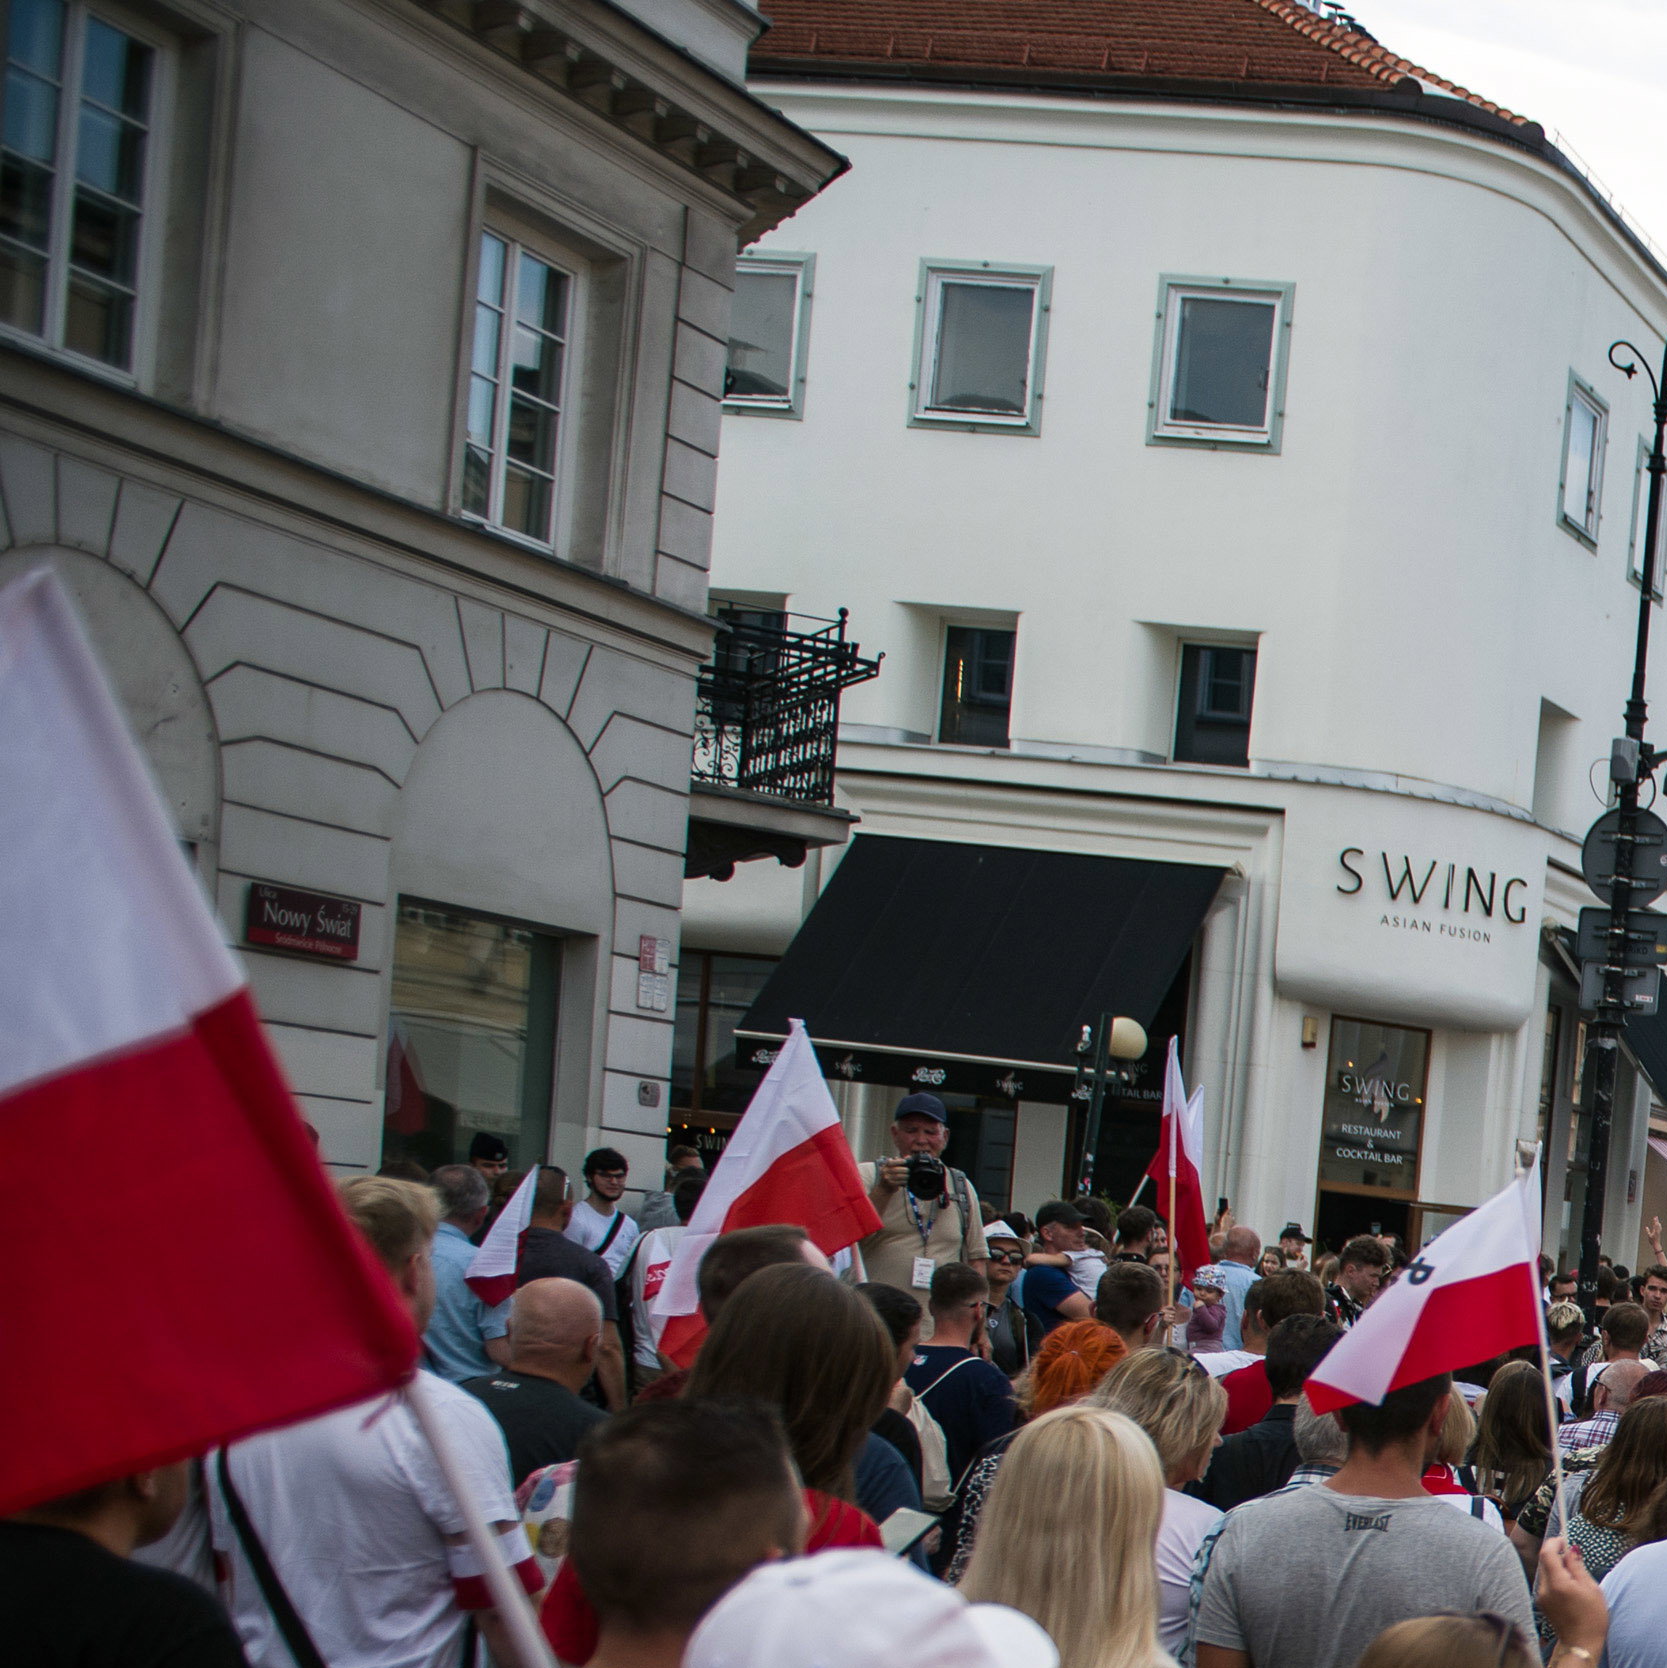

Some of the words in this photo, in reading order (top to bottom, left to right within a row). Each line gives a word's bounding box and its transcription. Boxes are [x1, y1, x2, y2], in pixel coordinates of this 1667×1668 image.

[1336, 847, 1528, 925] SWING
[264, 900, 312, 937] Nowy
[317, 904, 353, 939] Świat
[1380, 914, 1432, 934] ASIAN
[1440, 923, 1492, 944] FUSION
[1341, 1074, 1410, 1101] SWING
[1341, 1123, 1402, 1140] RESTAURANT
[1336, 1147, 1383, 1163] COCKTAIL
[1384, 1151, 1403, 1165] BAR
